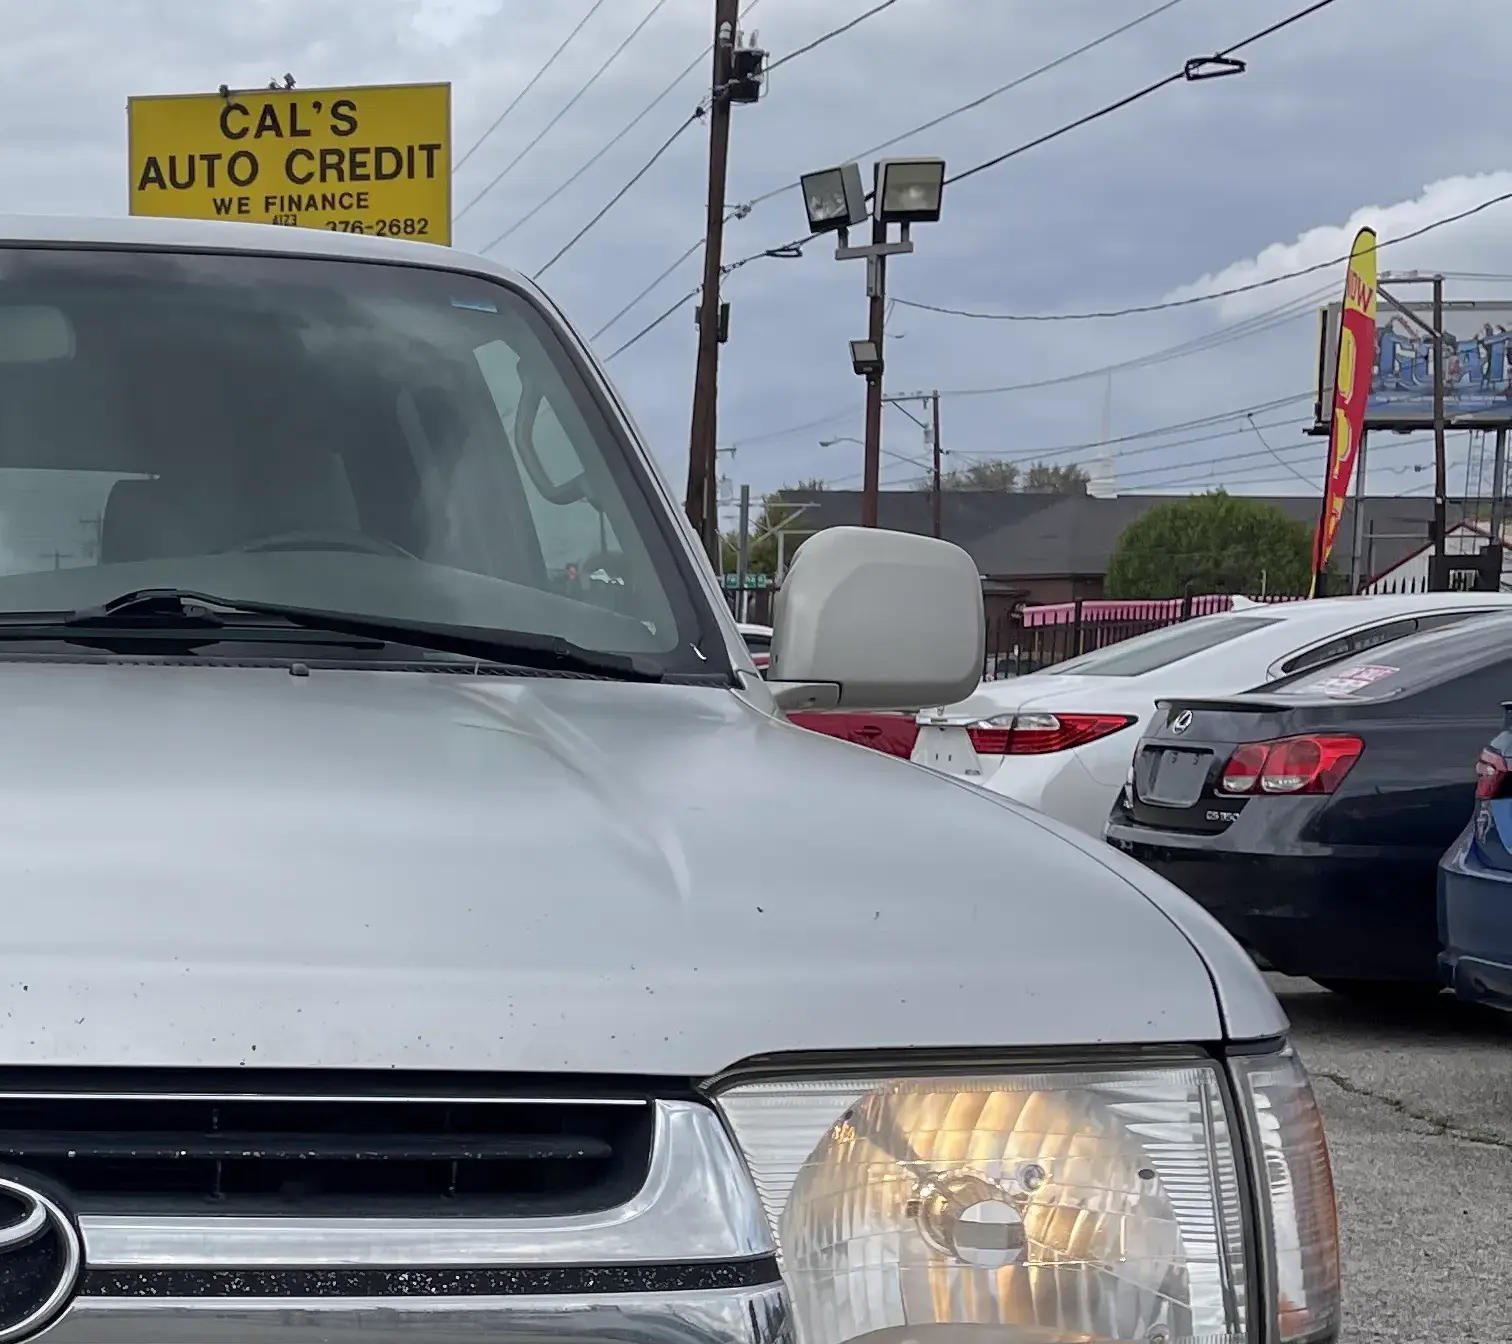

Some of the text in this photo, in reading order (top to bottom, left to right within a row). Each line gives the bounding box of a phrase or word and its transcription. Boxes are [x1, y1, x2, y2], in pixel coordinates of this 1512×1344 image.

[219, 100, 358, 140] CAL'S
[138, 144, 441, 191] AUTO CREDIT
[213, 192, 369, 215] WE FINANCE
